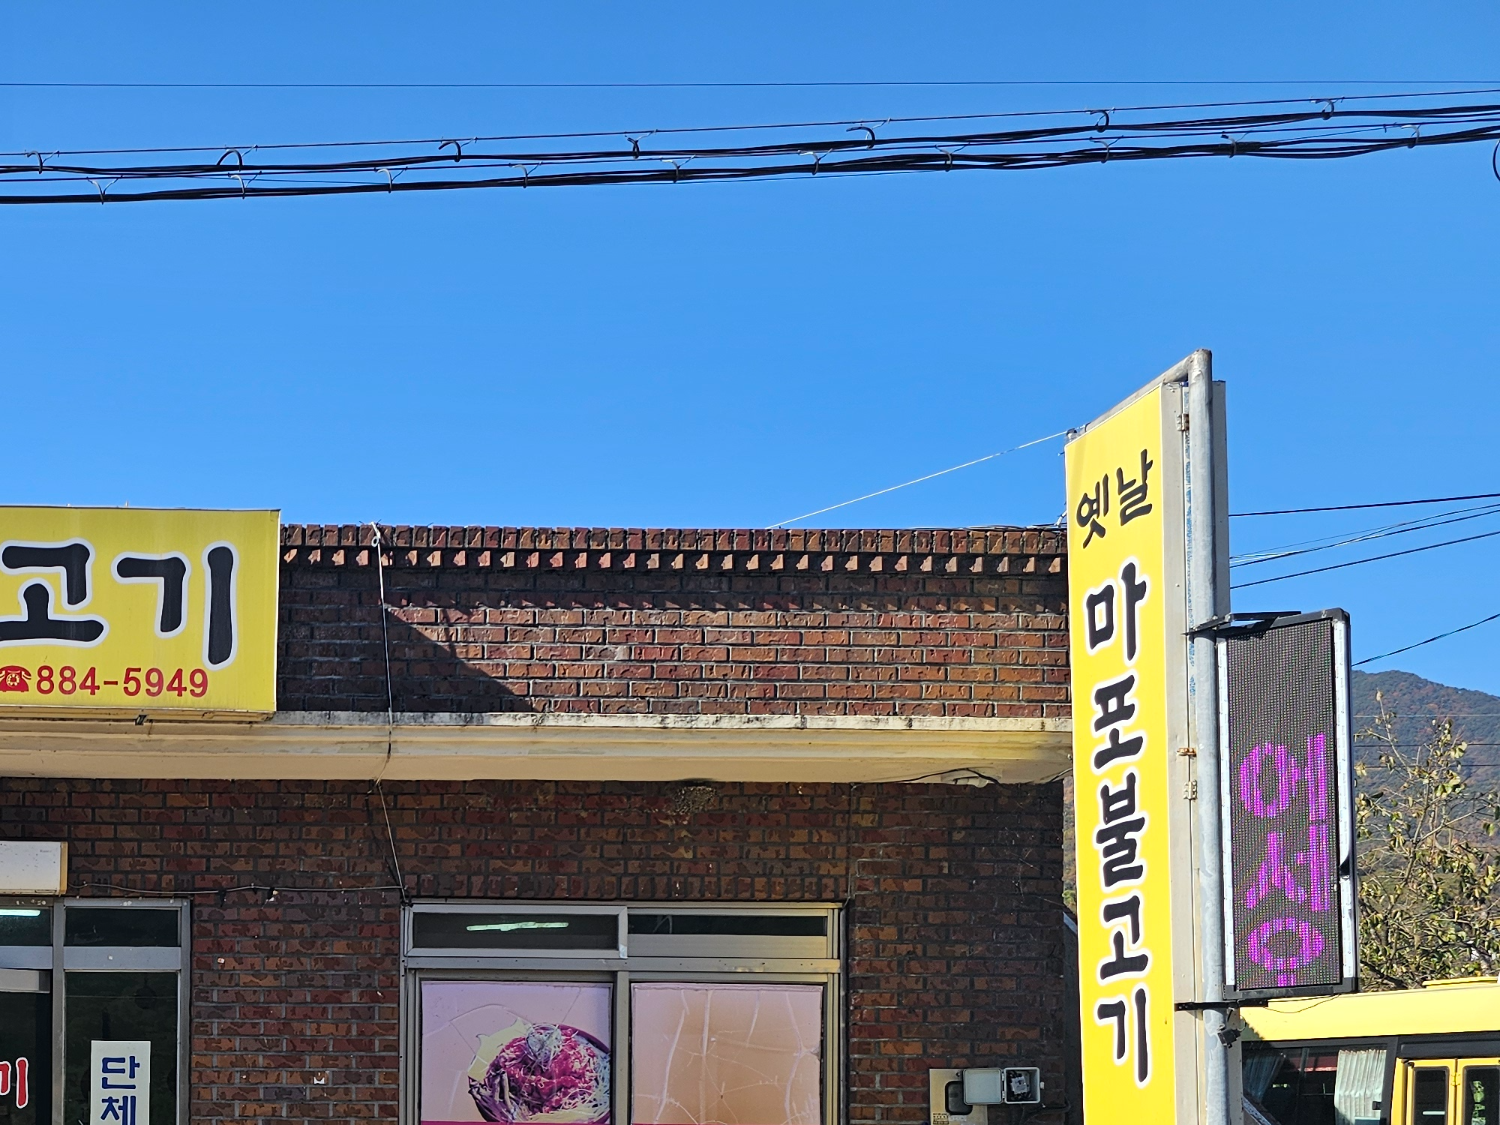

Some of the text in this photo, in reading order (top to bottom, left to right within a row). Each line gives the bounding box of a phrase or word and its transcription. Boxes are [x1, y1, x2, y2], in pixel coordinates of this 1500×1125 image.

[1076, 448, 1154, 549] 옛날
[37, 666, 208, 699] 884-5949
[1083, 557, 1150, 1086] 마포불고기
